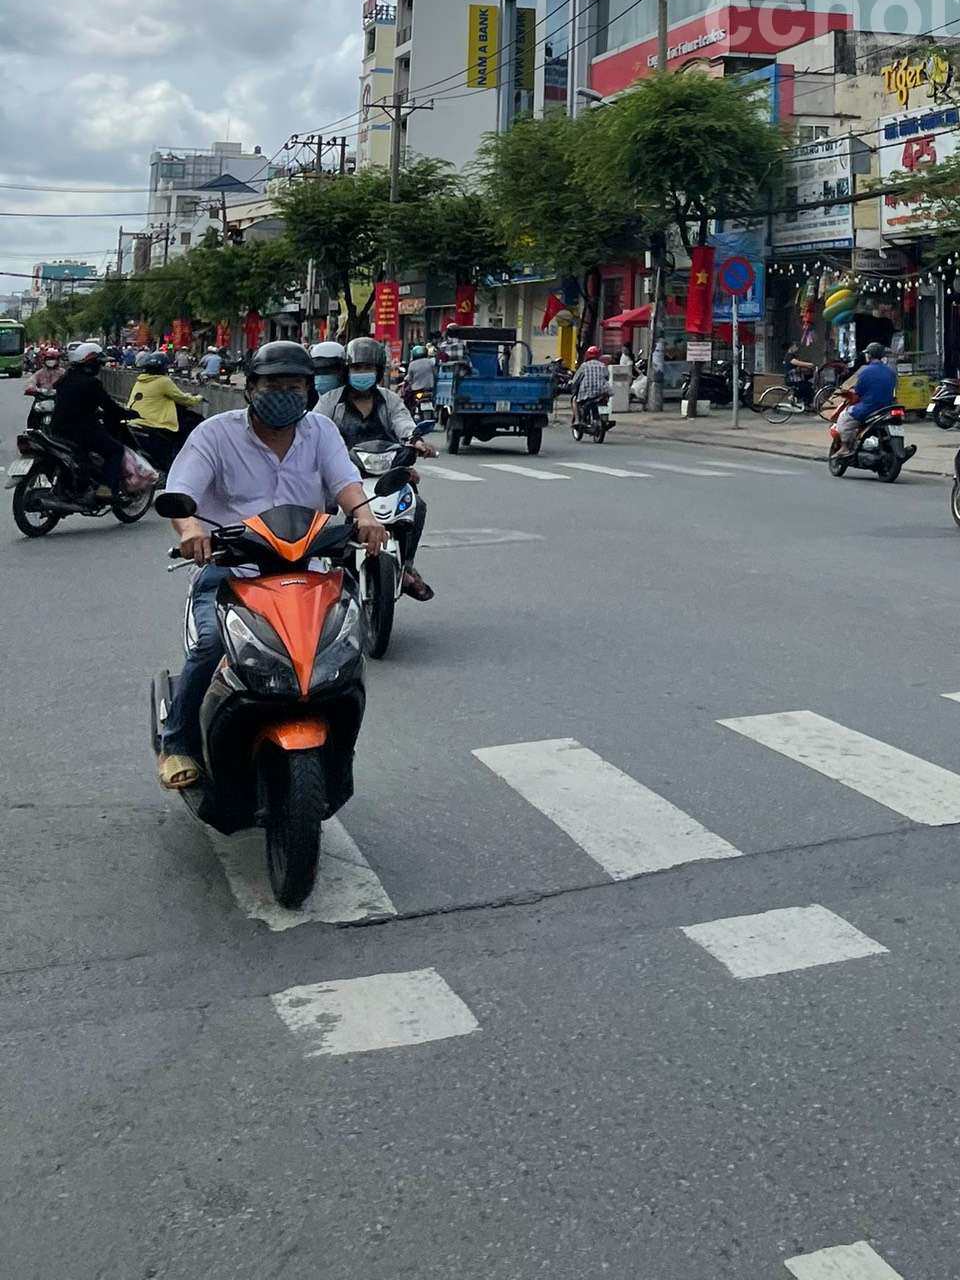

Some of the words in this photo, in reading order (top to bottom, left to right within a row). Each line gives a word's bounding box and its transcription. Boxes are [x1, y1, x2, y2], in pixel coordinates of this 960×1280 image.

[479, 8, 489, 42] BANK
[478, 45, 489, 54] A
[478, 56, 488, 86] NAM
[880, 56, 928, 106] Tiger
